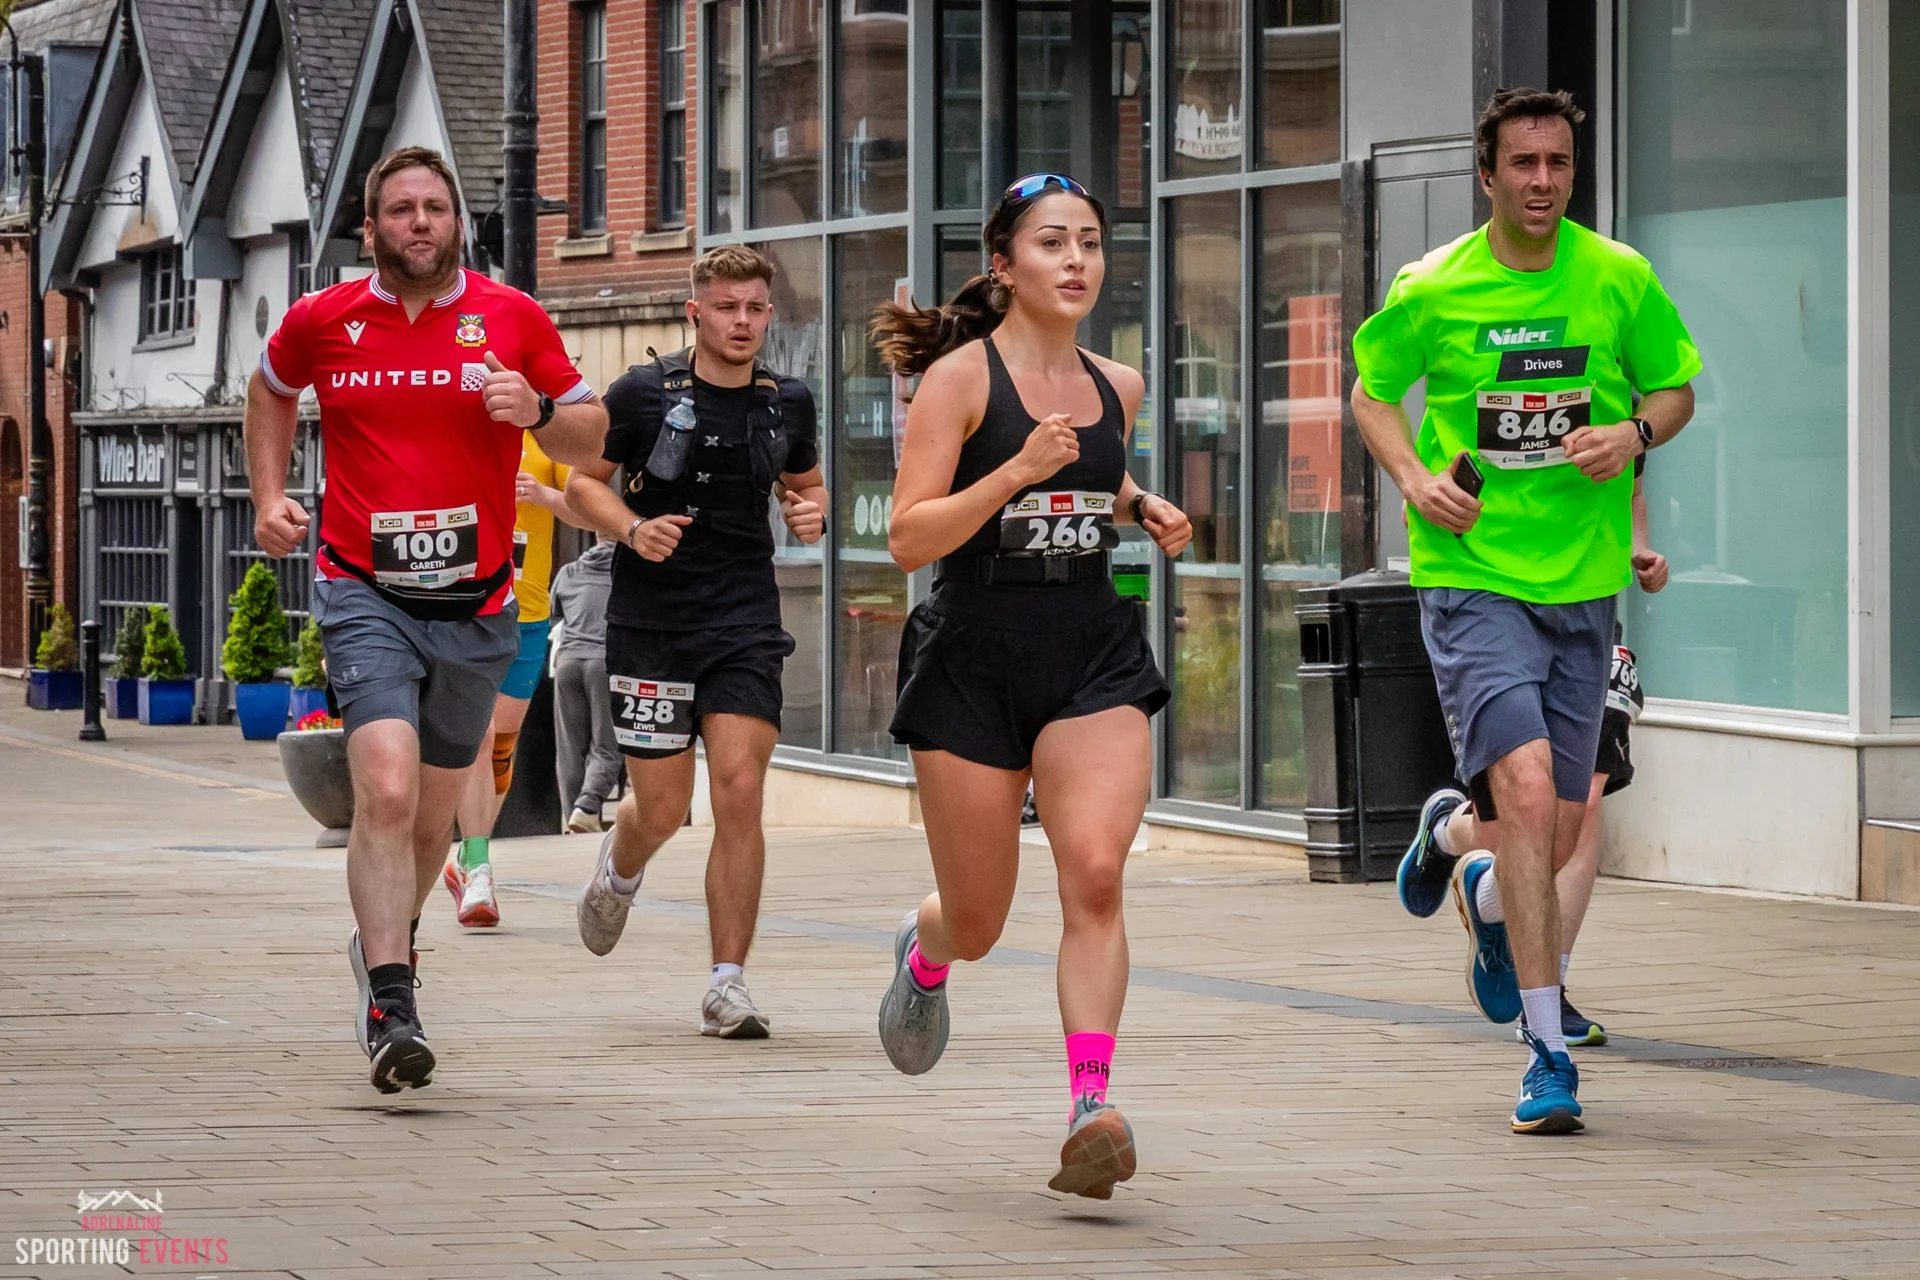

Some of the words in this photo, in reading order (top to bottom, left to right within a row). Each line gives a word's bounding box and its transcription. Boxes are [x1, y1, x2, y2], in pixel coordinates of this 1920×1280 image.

[1486, 327, 1554, 346] Nidec
[1524, 359, 1563, 371] Drives
[332, 370, 452, 388] UNITED
[1558, 393, 1580, 402] JCB
[1497, 408, 1571, 440] 846
[1520, 439, 1550, 450] JAMES
[136, 434, 165, 483] bar
[1014, 501, 1038, 511] JCB
[1086, 499, 1104, 508] JCB
[449, 513, 468, 522] JCB
[380, 520, 402, 528] JCB
[1025, 516, 1101, 549] 266
[393, 530, 458, 560] 100
[410, 560, 445, 570] GARETH
[621, 695, 675, 724] 258
[633, 722, 656, 732] LEWIS
